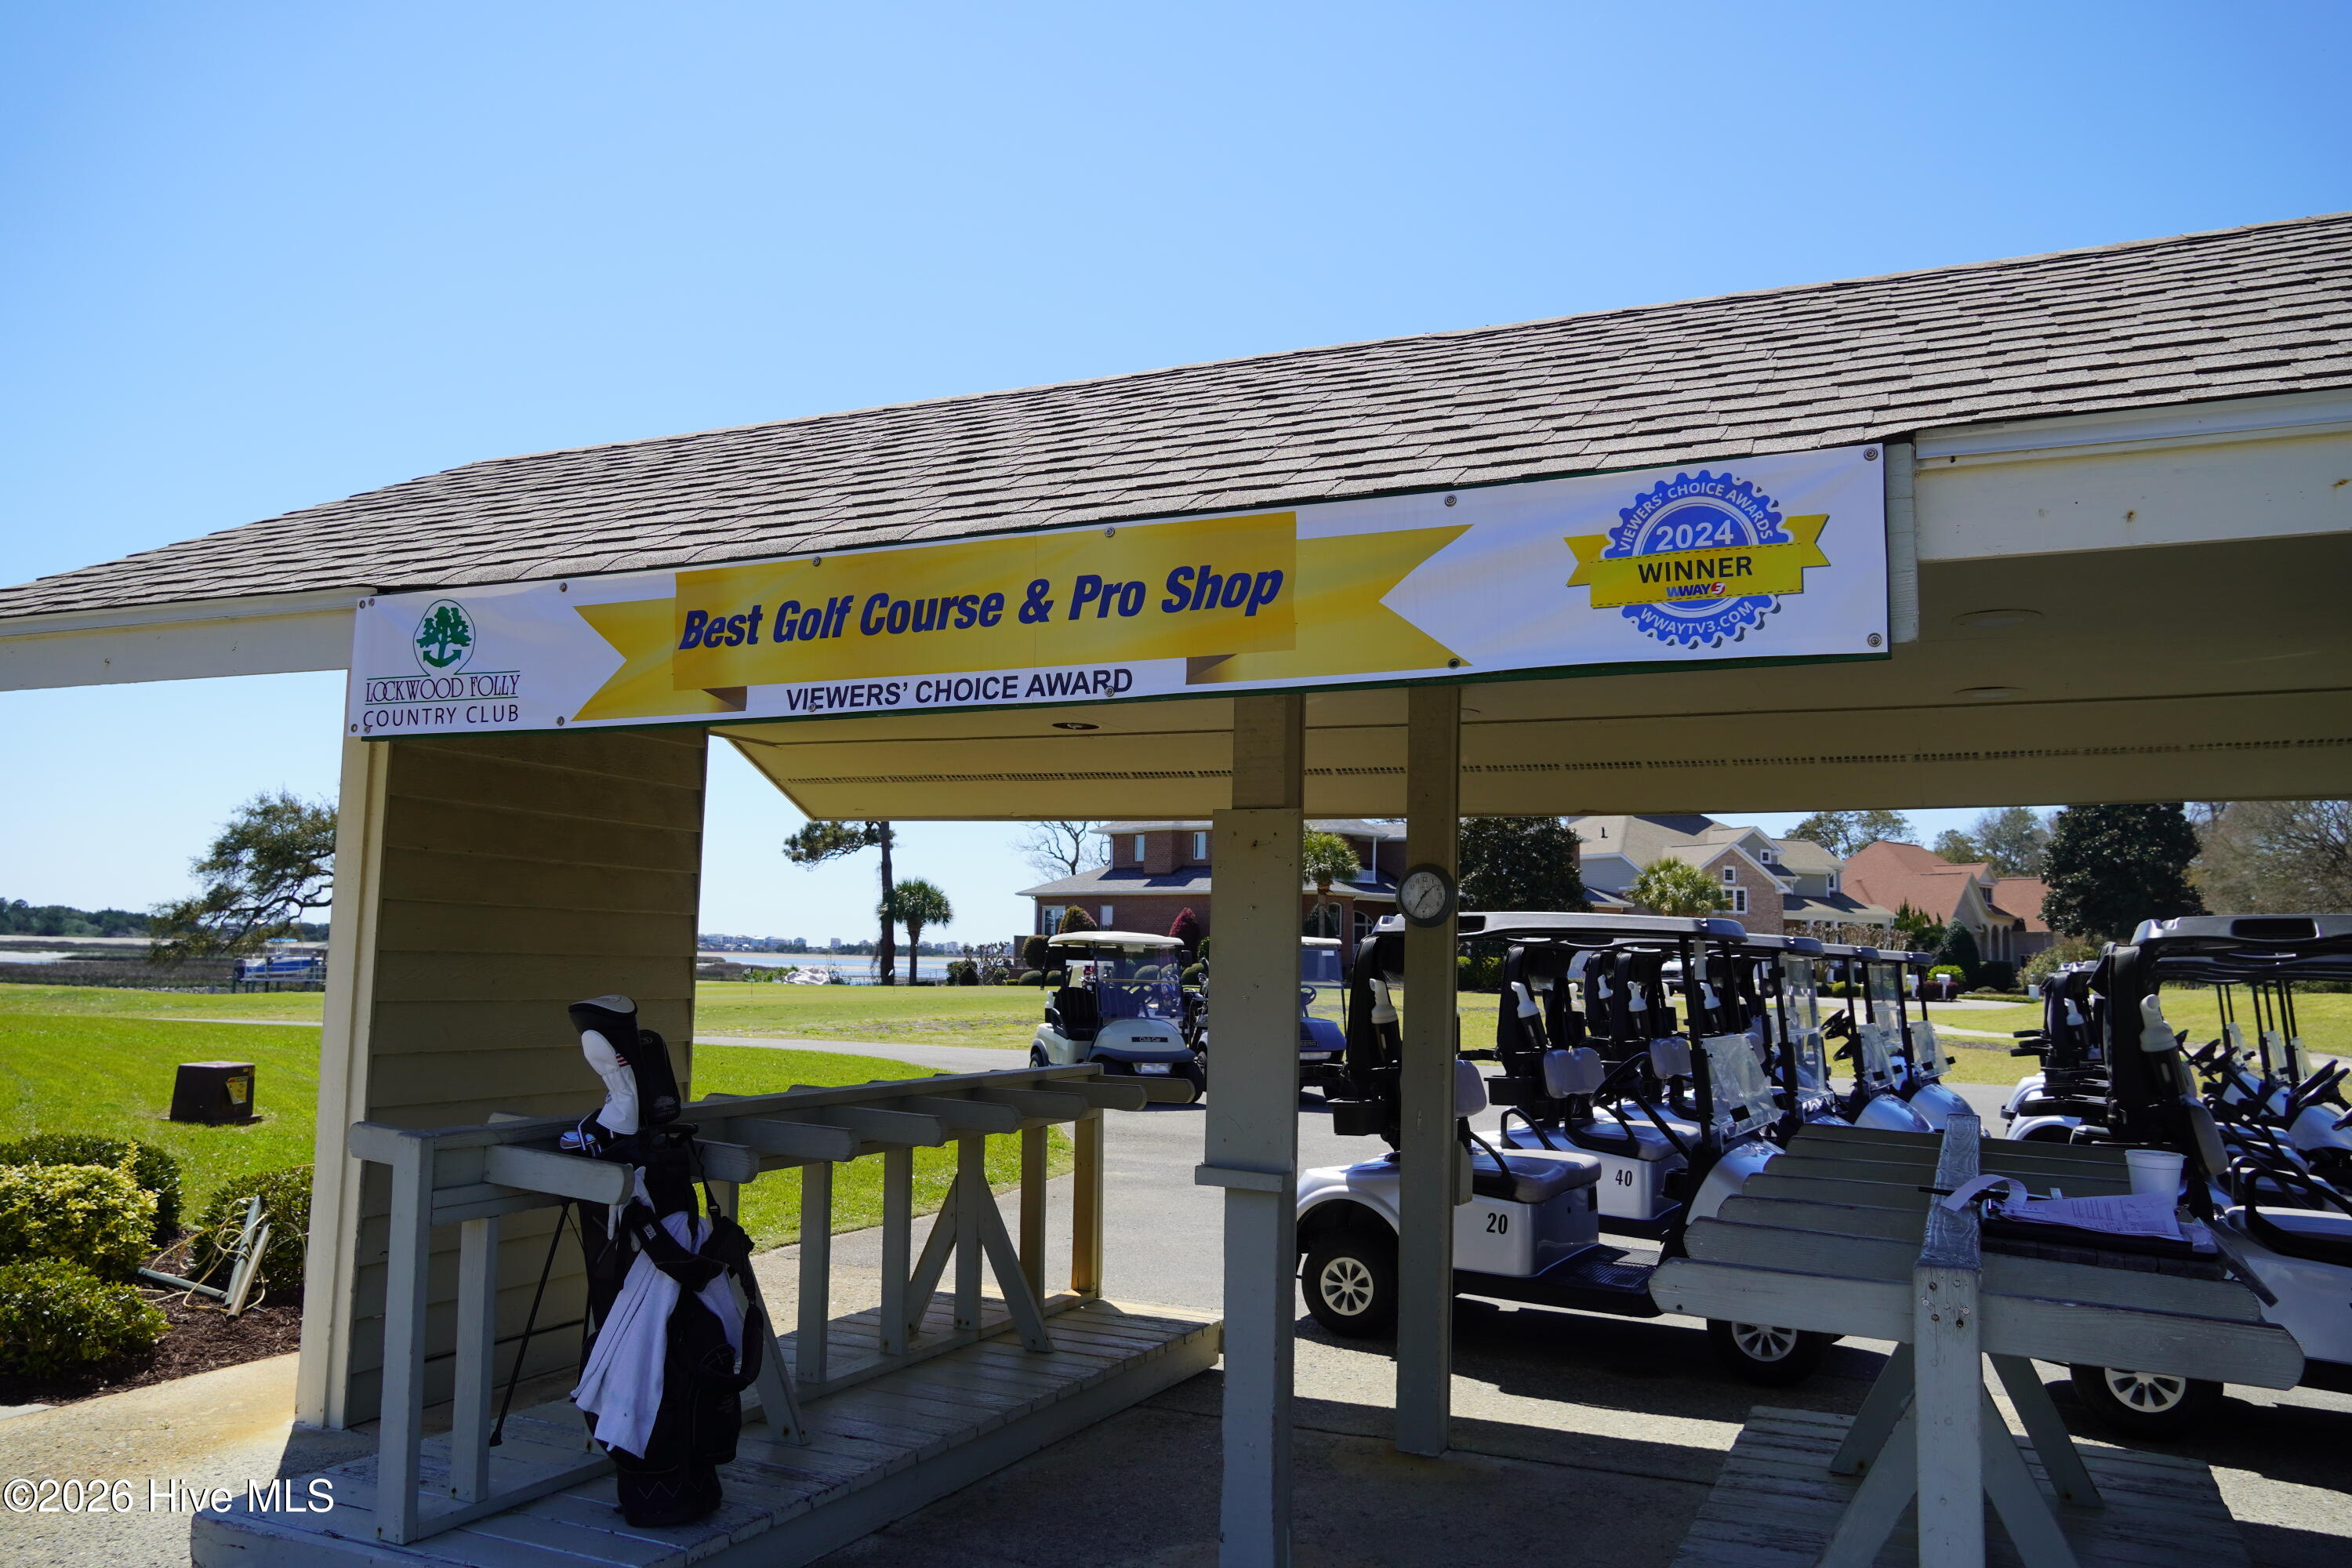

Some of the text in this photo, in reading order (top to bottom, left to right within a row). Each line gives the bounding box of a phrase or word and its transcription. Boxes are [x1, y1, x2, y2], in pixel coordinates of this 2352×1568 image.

[1618, 482, 1773, 551] VIEWERS’ CHOICE AWARDS
[1656, 519, 1734, 551] 2024
[1638, 556, 1753, 584] WINNER
[678, 564, 1283, 650] Best Golf Course & Pro Shop
[1640, 601, 1754, 634] WWAYTV3.COM
[365, 674, 521, 702] LOCKWOOD FOLLY
[786, 668, 1133, 711] VIEWERS’ CHOICE AWARD
[363, 704, 519, 728] COUNTRY CLUB
[1615, 1169, 1633, 1187] 40
[1486, 1212, 1508, 1235] 20
